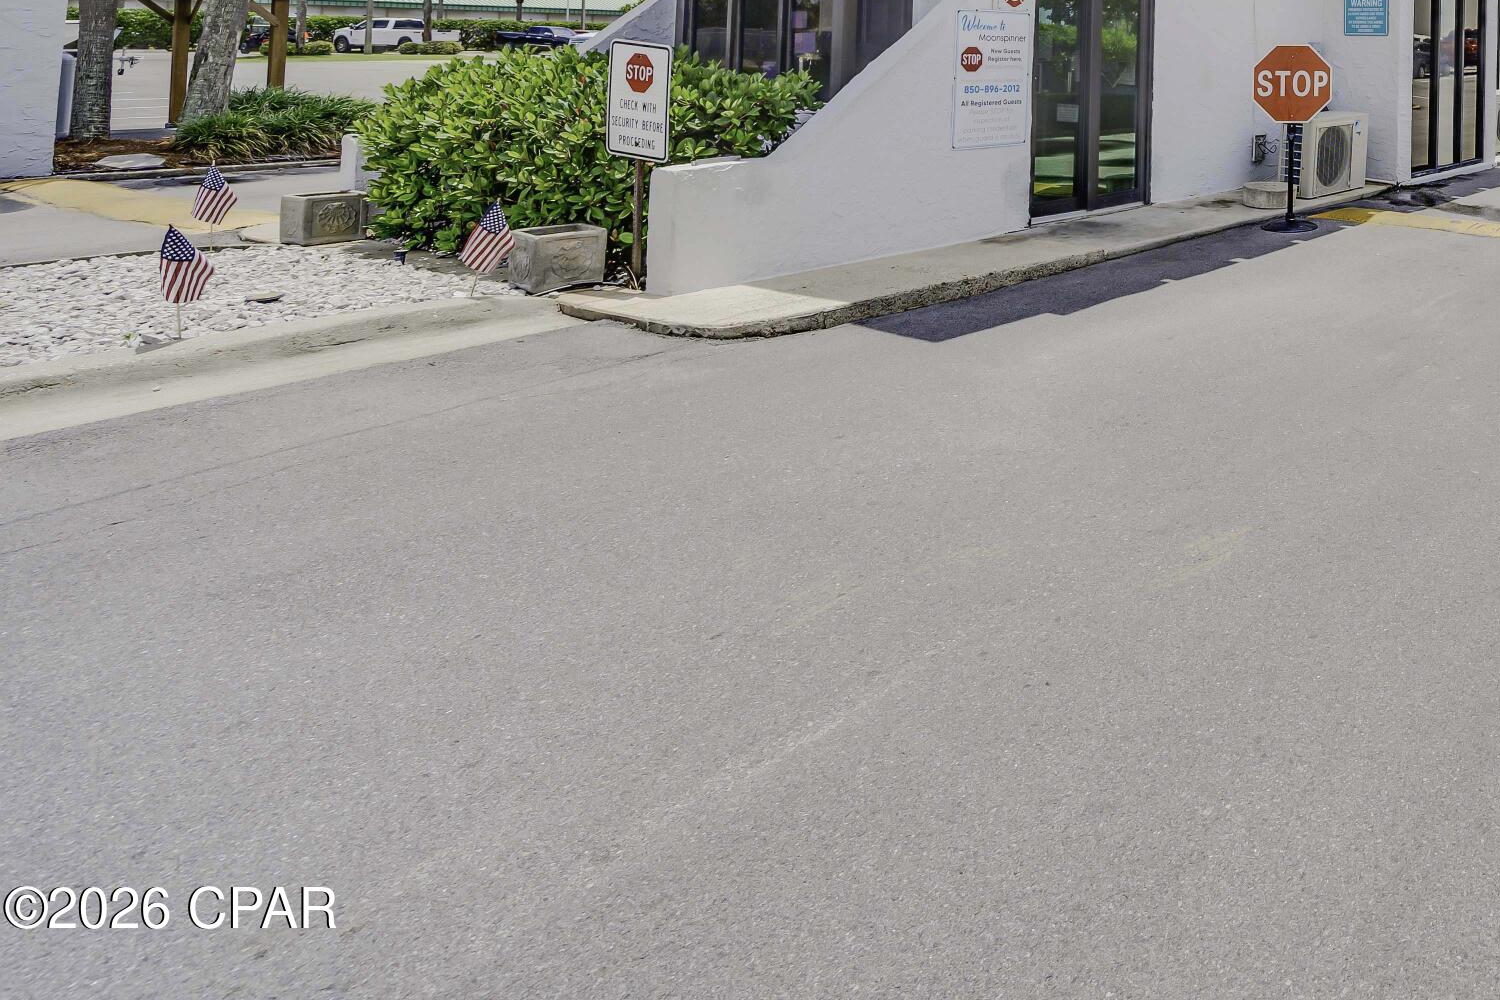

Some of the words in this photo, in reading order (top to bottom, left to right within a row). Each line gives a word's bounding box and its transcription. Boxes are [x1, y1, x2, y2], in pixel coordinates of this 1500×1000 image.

[978, 34, 1027, 43] Moonspinner
[962, 54, 982, 65] STOP
[626, 64, 653, 81] STOP
[964, 84, 1020, 94] 850-896-2012
[1257, 70, 1329, 97] STOP
[619, 98, 638, 111] CHECK
[642, 102, 657, 113] WITH
[970, 99, 1001, 107] Registered
[611, 115, 639, 129] SECURITY
[642, 120, 664, 134] BEFORE
[619, 134, 656, 151] PROCEEDING
